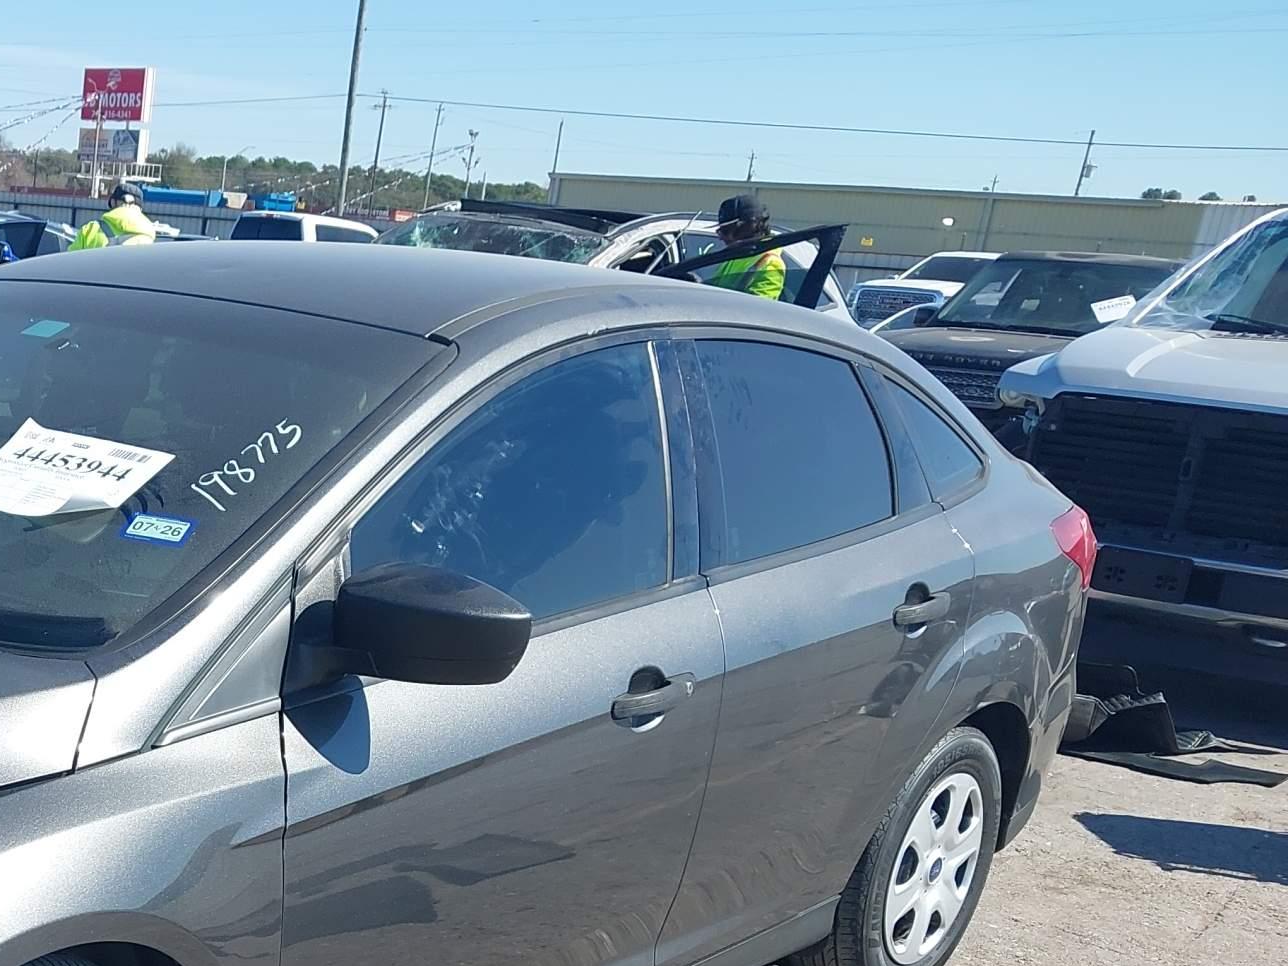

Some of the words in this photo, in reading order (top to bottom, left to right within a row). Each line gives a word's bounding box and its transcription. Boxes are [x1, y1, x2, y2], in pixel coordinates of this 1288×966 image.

[99, 92, 142, 107] MOTORS
[13, 446, 133, 482] 44453944
[132, 521, 155, 532] 07
[160, 525, 183, 537] 26
